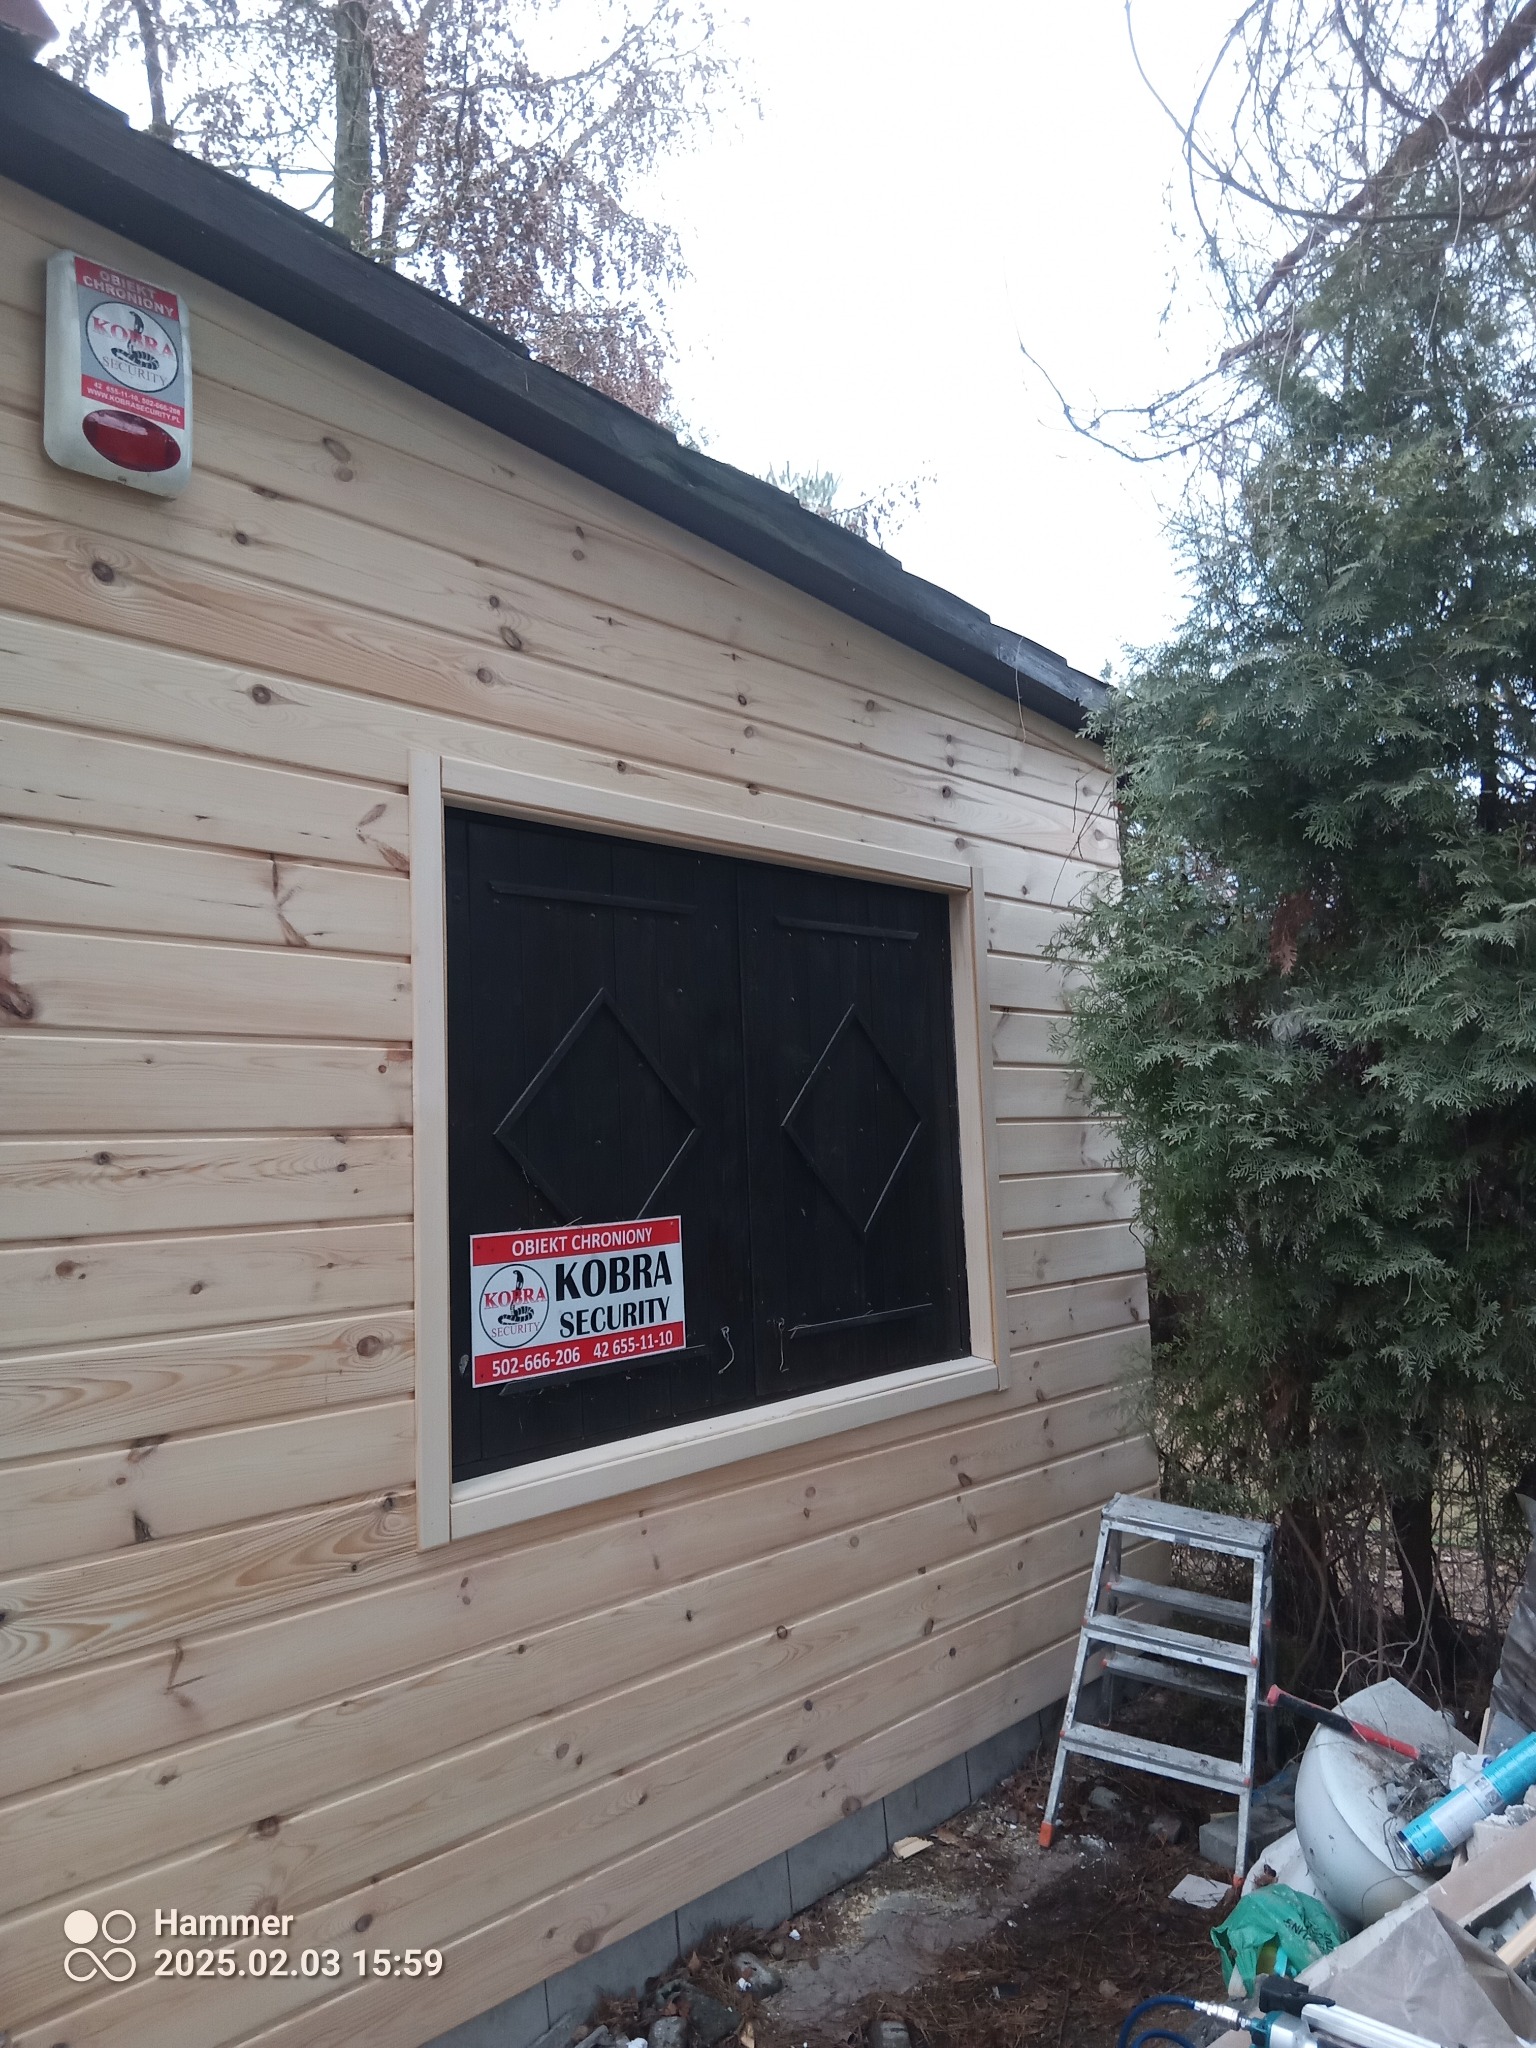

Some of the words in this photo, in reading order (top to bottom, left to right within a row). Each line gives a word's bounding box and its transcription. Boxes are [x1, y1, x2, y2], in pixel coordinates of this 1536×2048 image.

[82, 275, 174, 317] CHRONIONY
[100, 270, 155, 299] OBIEKT
[92, 315, 174, 358] KOBRA
[93, 381, 103, 389] 42
[102, 356, 168, 387] SECURITY
[86, 386, 181, 424] WWW.KOBRASECURITY.PL
[511, 1235, 568, 1257] OBIEKT
[571, 1226, 653, 1251] CHRONIONY
[555, 1250, 673, 1302] KOBRA
[483, 1286, 549, 1310] KOBRA
[491, 1321, 541, 1338] SECURITY
[559, 1295, 671, 1339] SECURITY
[492, 1346, 581, 1378] 502-666-206
[593, 1342, 609, 1359] 42
[612, 1329, 674, 1356] 655-11-10
